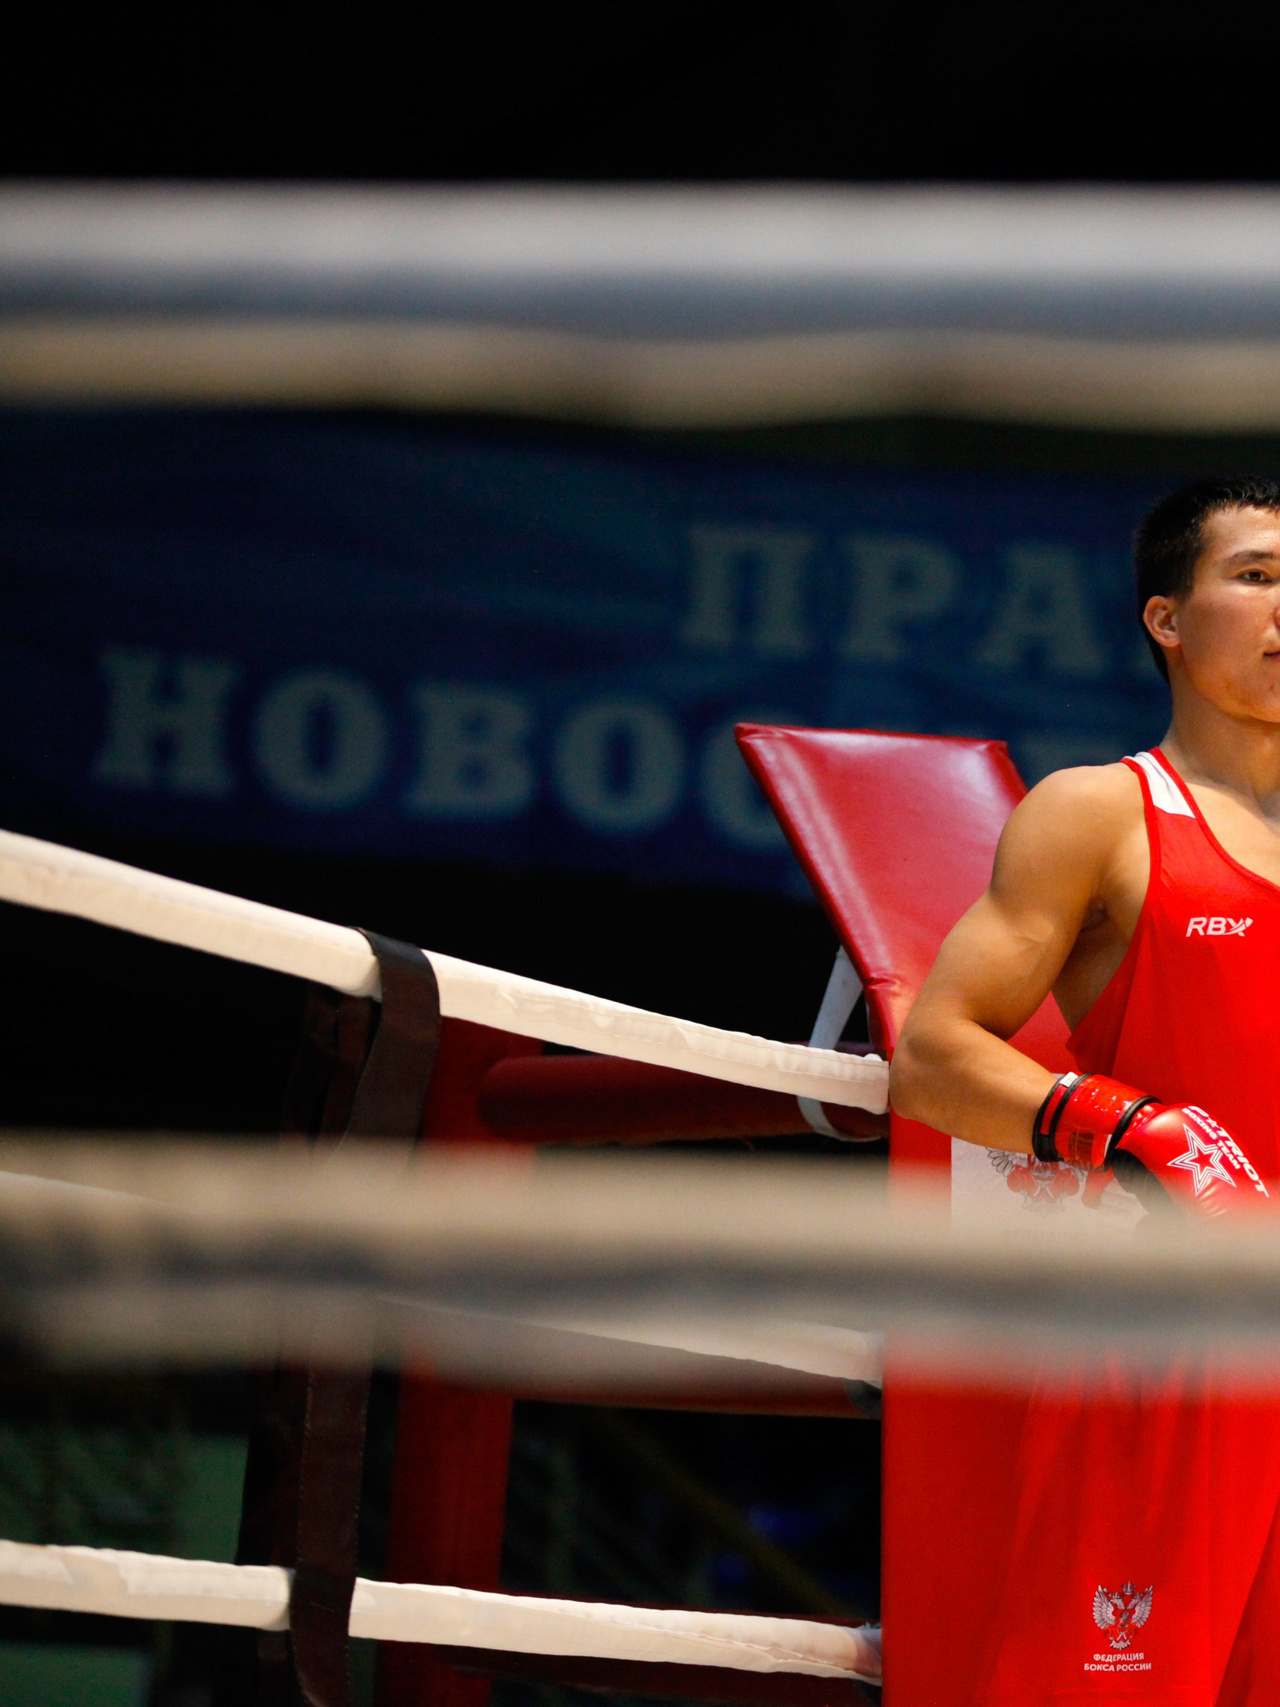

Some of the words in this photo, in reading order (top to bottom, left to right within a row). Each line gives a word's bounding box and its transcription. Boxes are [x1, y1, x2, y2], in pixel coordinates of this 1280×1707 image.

[1185, 916, 1254, 937] RBX
[1181, 1107, 1218, 1140] BOXING
[1217, 1139, 1242, 1170] TEAM
[1092, 1652, 1145, 1663] ФЕДЕРАЦИЯ
[1083, 1662, 1115, 1672] БОКСА
[1116, 1662, 1152, 1672] РОССИИ
